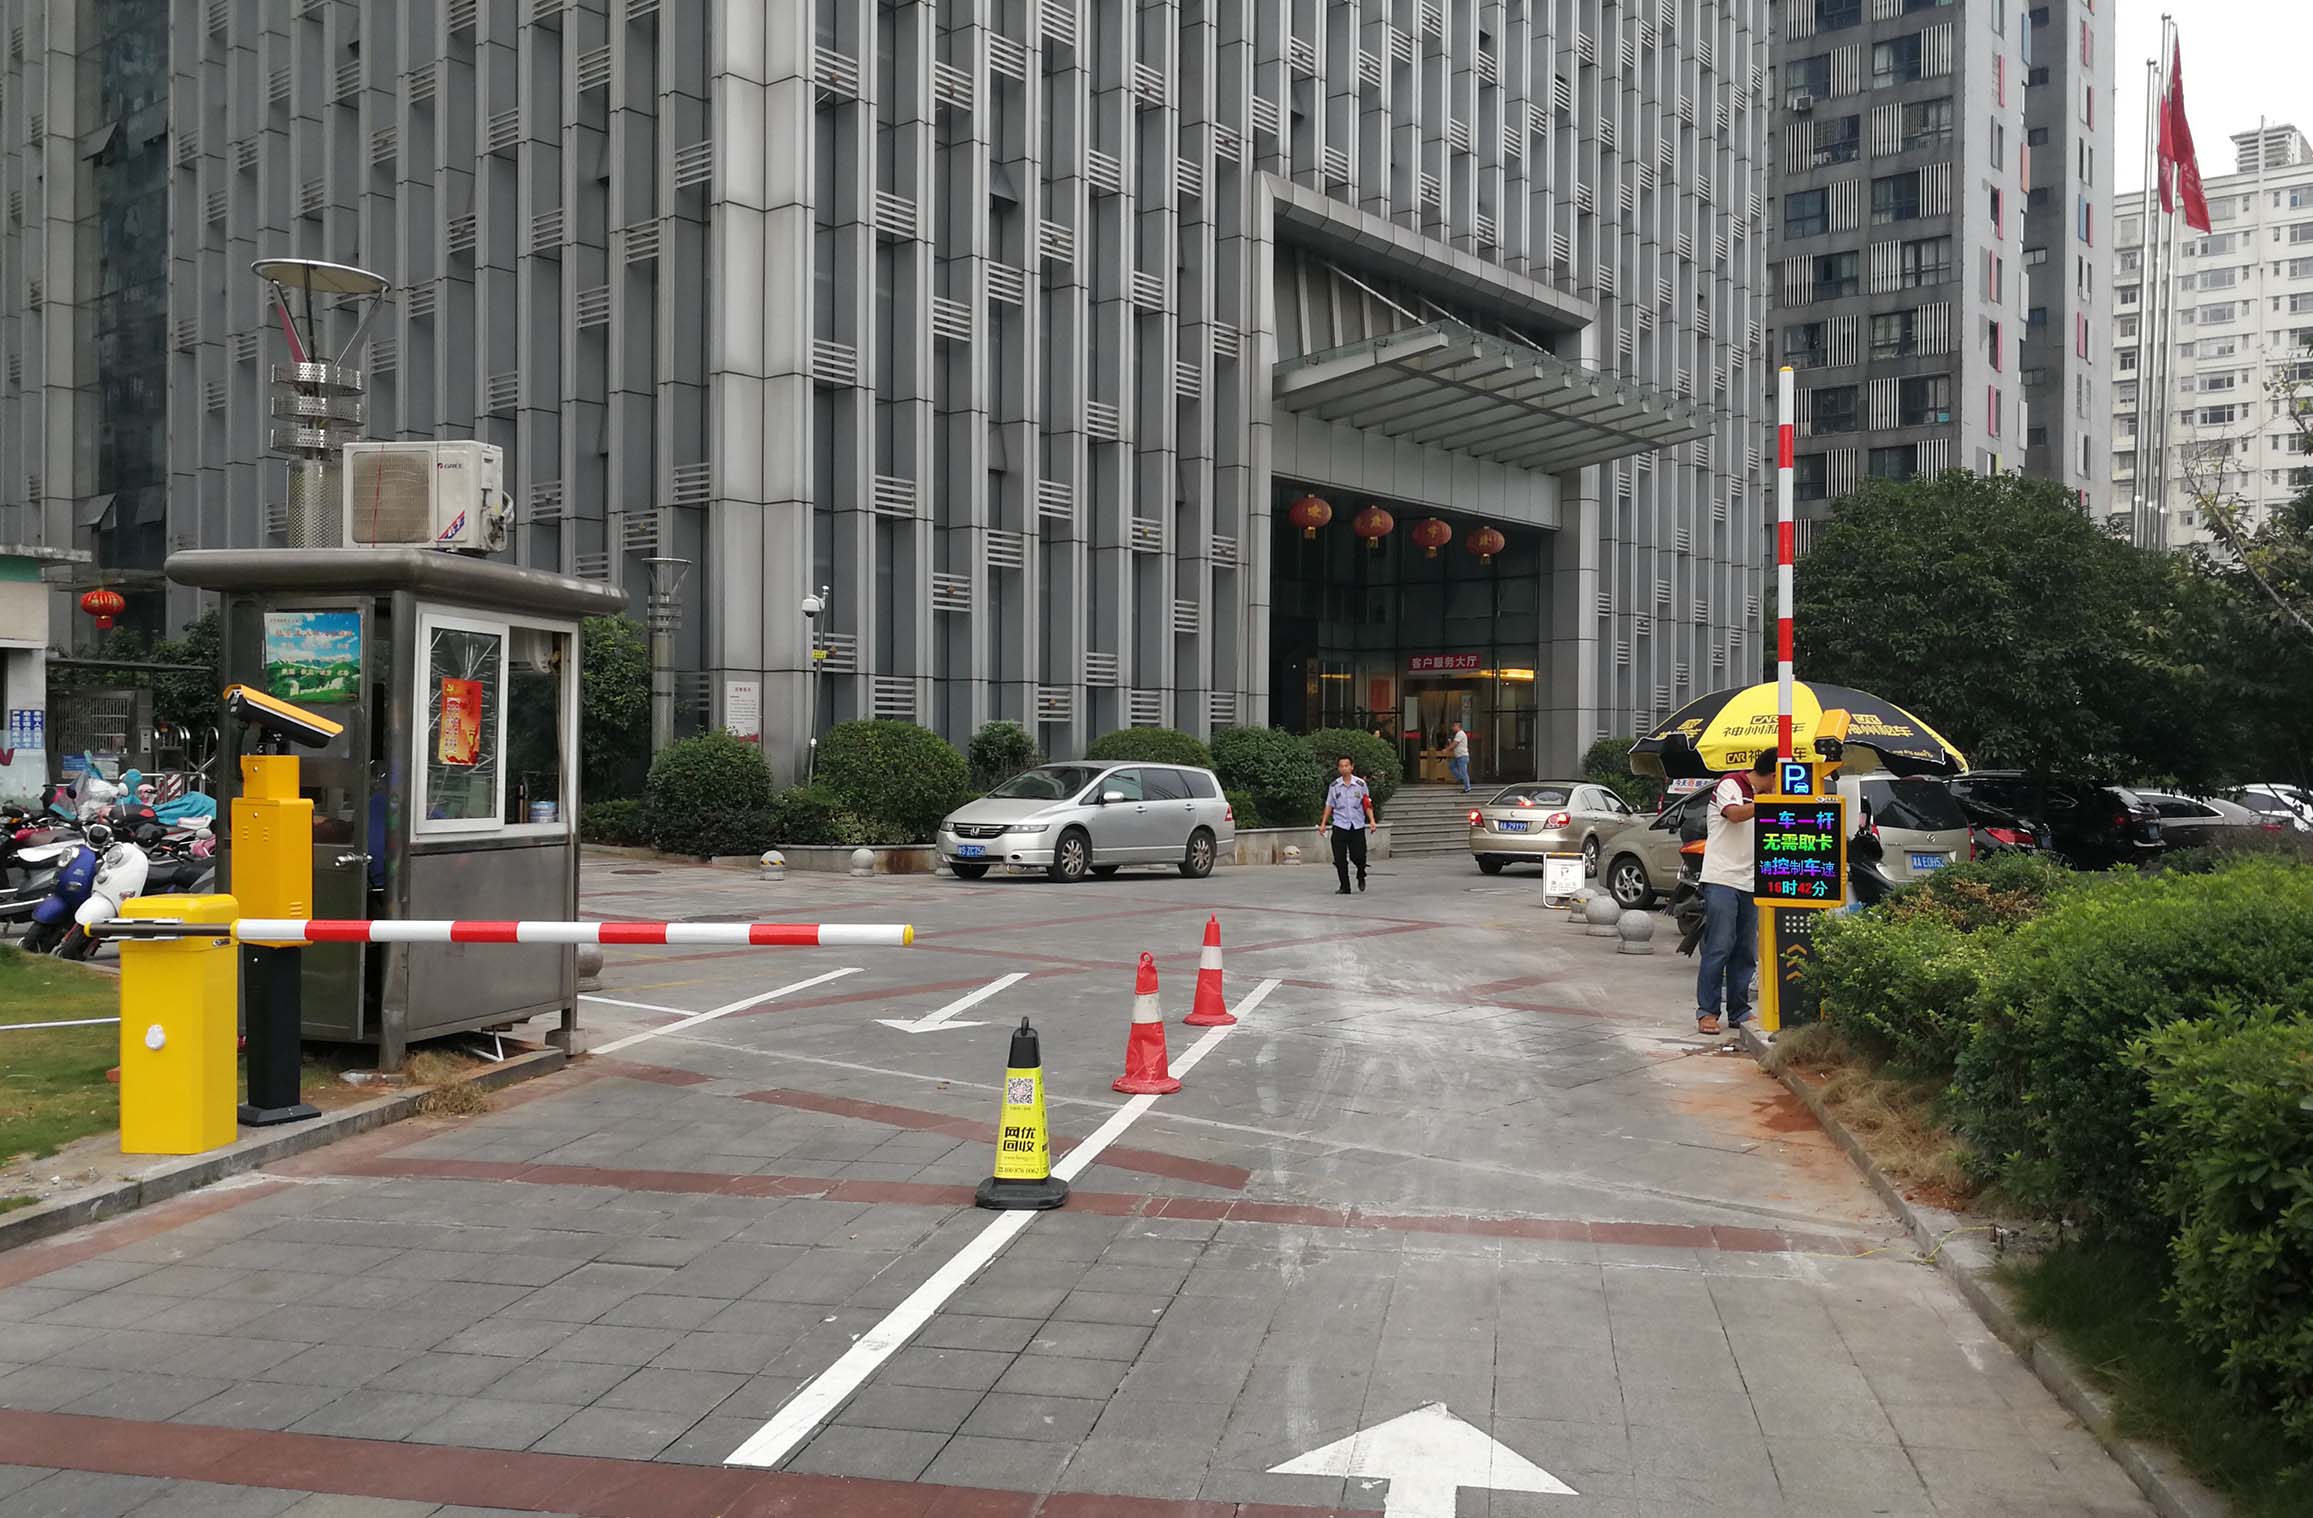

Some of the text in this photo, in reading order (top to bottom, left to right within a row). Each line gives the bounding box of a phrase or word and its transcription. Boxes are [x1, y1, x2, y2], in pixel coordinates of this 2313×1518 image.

[1412, 655, 1477, 669] 客户服务大厅
[1727, 753, 1746, 763] CAR
[1785, 764, 1806, 791] P
[1759, 811, 1835, 830] 一车一杆
[1762, 833, 1833, 851] 无需取卡
[1759, 857, 1836, 877] 请控制车速
[1004, 1126, 1036, 1139] 网优
[1002, 1140, 1035, 1152] 回收
